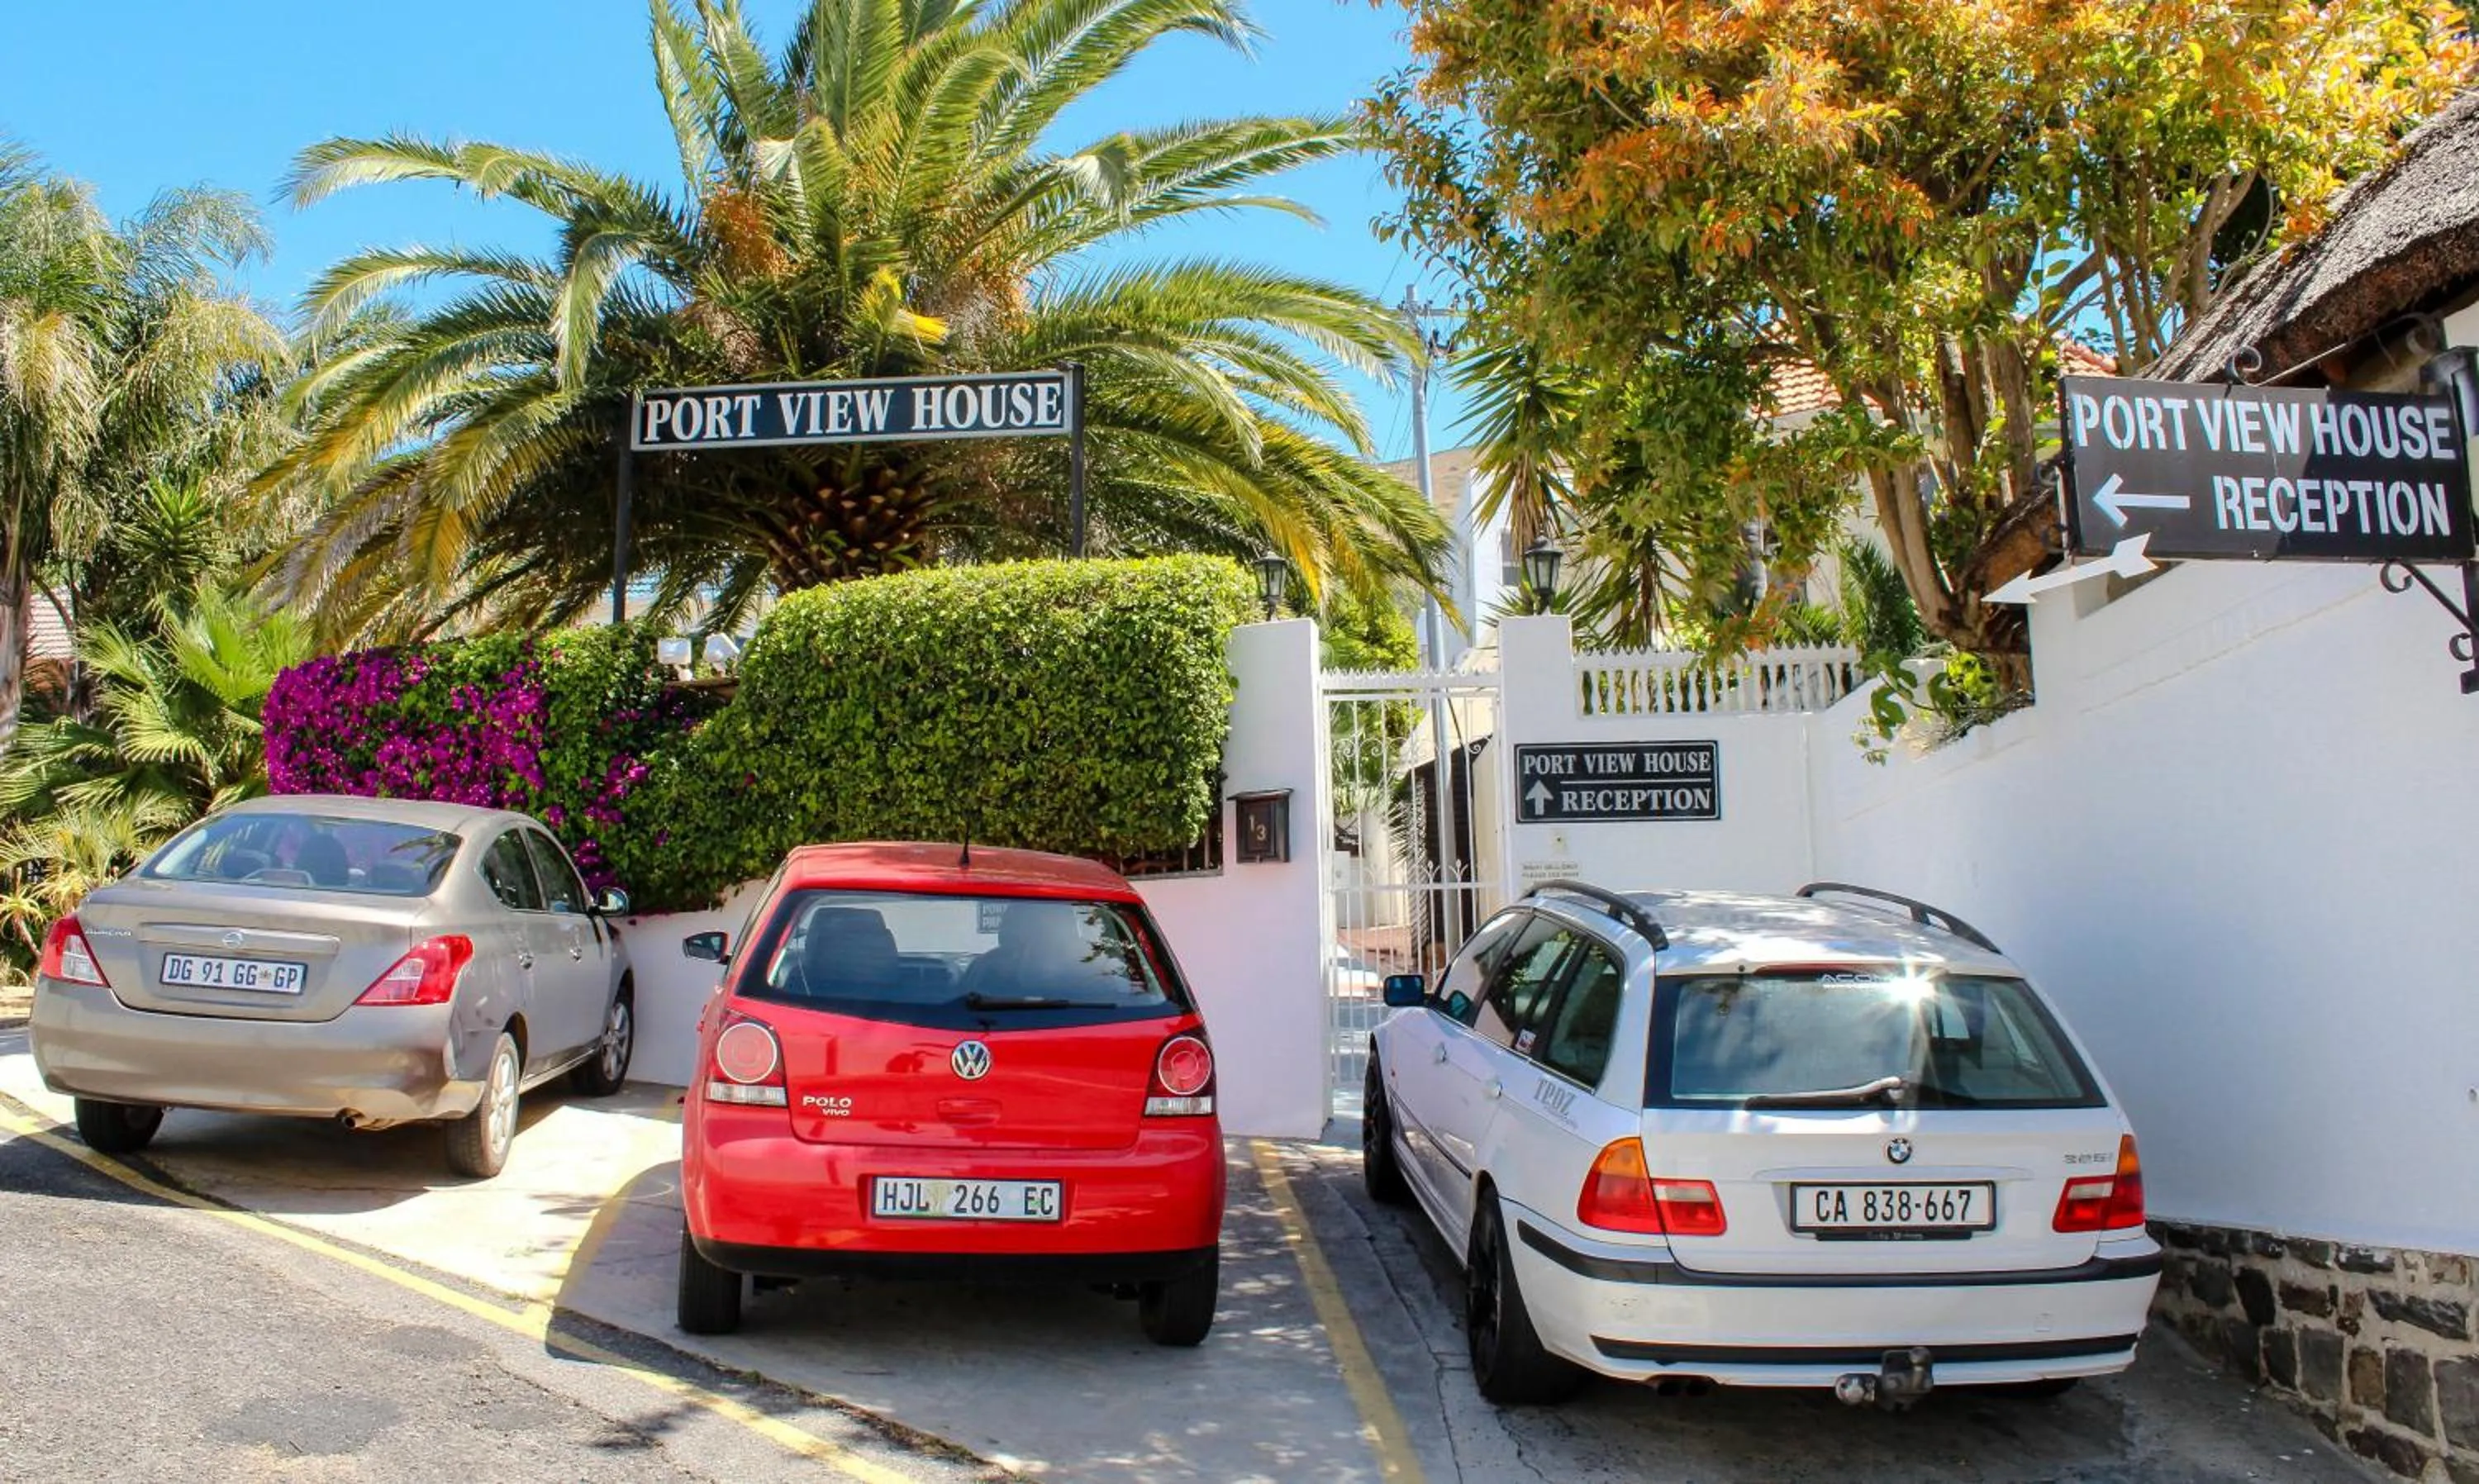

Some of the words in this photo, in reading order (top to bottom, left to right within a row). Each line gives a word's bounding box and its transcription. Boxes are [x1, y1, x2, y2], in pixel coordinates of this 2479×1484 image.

[643, 394, 761, 442] PORT
[778, 388, 893, 436] VIEW
[911, 382, 1062, 430] HOUSE
[2071, 394, 2189, 450] PORT
[2194, 398, 2301, 454] VIEW
[2310, 402, 2457, 460] HOUSE
[2212, 474, 2452, 536] RECEPTION
[1523, 754, 1577, 775] PORT
[1584, 753, 1636, 774] VIEW
[1644, 751, 1711, 773] HOUSE
[1561, 787, 1711, 812] RECEPTION
[1249, 814, 1267, 841] 13
[168, 958, 193, 981] DG
[202, 962, 224, 983] 91
[233, 963, 258, 986] GG
[274, 966, 298, 988] GP
[802, 1096, 852, 1108] POLO
[822, 1108, 850, 1116] VIVO
[883, 1182, 930, 1212] HJL
[954, 1184, 1000, 1214] 266
[1023, 1186, 1054, 1215] EC
[1815, 1190, 1849, 1222] CA
[1863, 1189, 1971, 1222] 838-667
